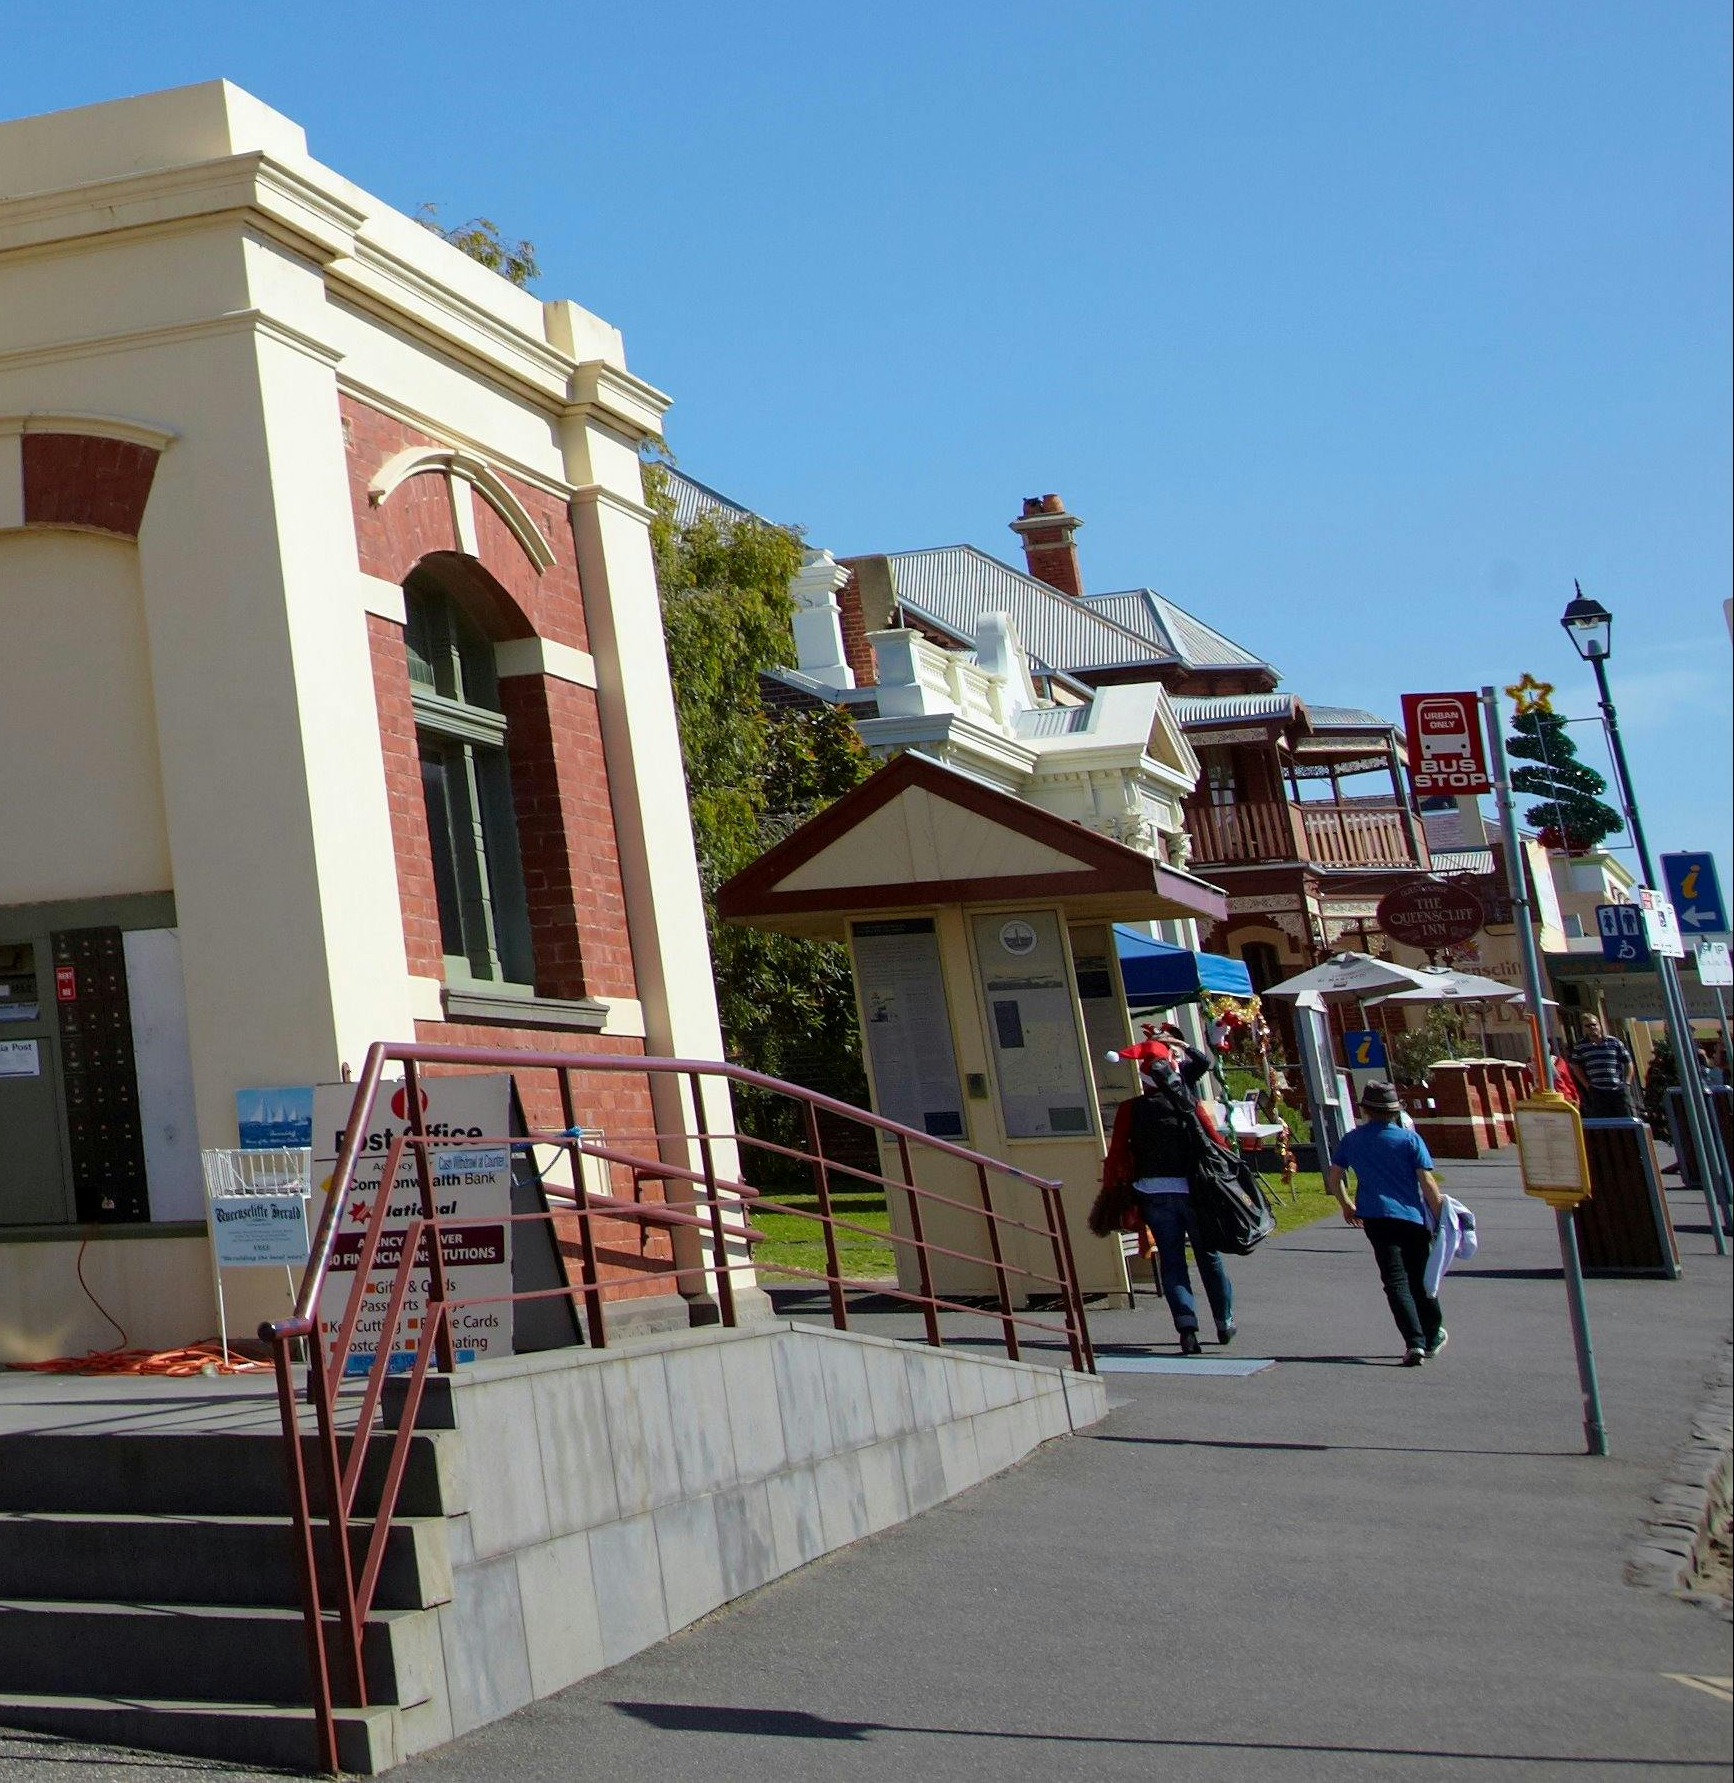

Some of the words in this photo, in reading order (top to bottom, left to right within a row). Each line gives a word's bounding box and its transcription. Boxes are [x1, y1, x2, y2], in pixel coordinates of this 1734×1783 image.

[1423, 711, 1459, 720] URBAN
[1429, 720, 1455, 729] ONLY
[1420, 758, 1477, 773] BUS
[1414, 773, 1487, 787] STOP
[1414, 898, 1442, 910] THE
[1390, 908, 1474, 926] QUEENSCLIFF
[1421, 923, 1448, 936] INN
[12, 1043, 32, 1052] Post
[335, 1128, 393, 1153] Pst
[349, 1173, 461, 1191] Comonwalth
[465, 1173, 496, 1185] Bank
[440, 1234, 463, 1244] VER
[343, 1252, 402, 1265] FINNCIA
[415, 1247, 496, 1262] NSTUTIONS
[408, 1280, 417, 1293] &
[361, 1300, 419, 1313] Passrts
[463, 1314, 499, 1328] Cards
